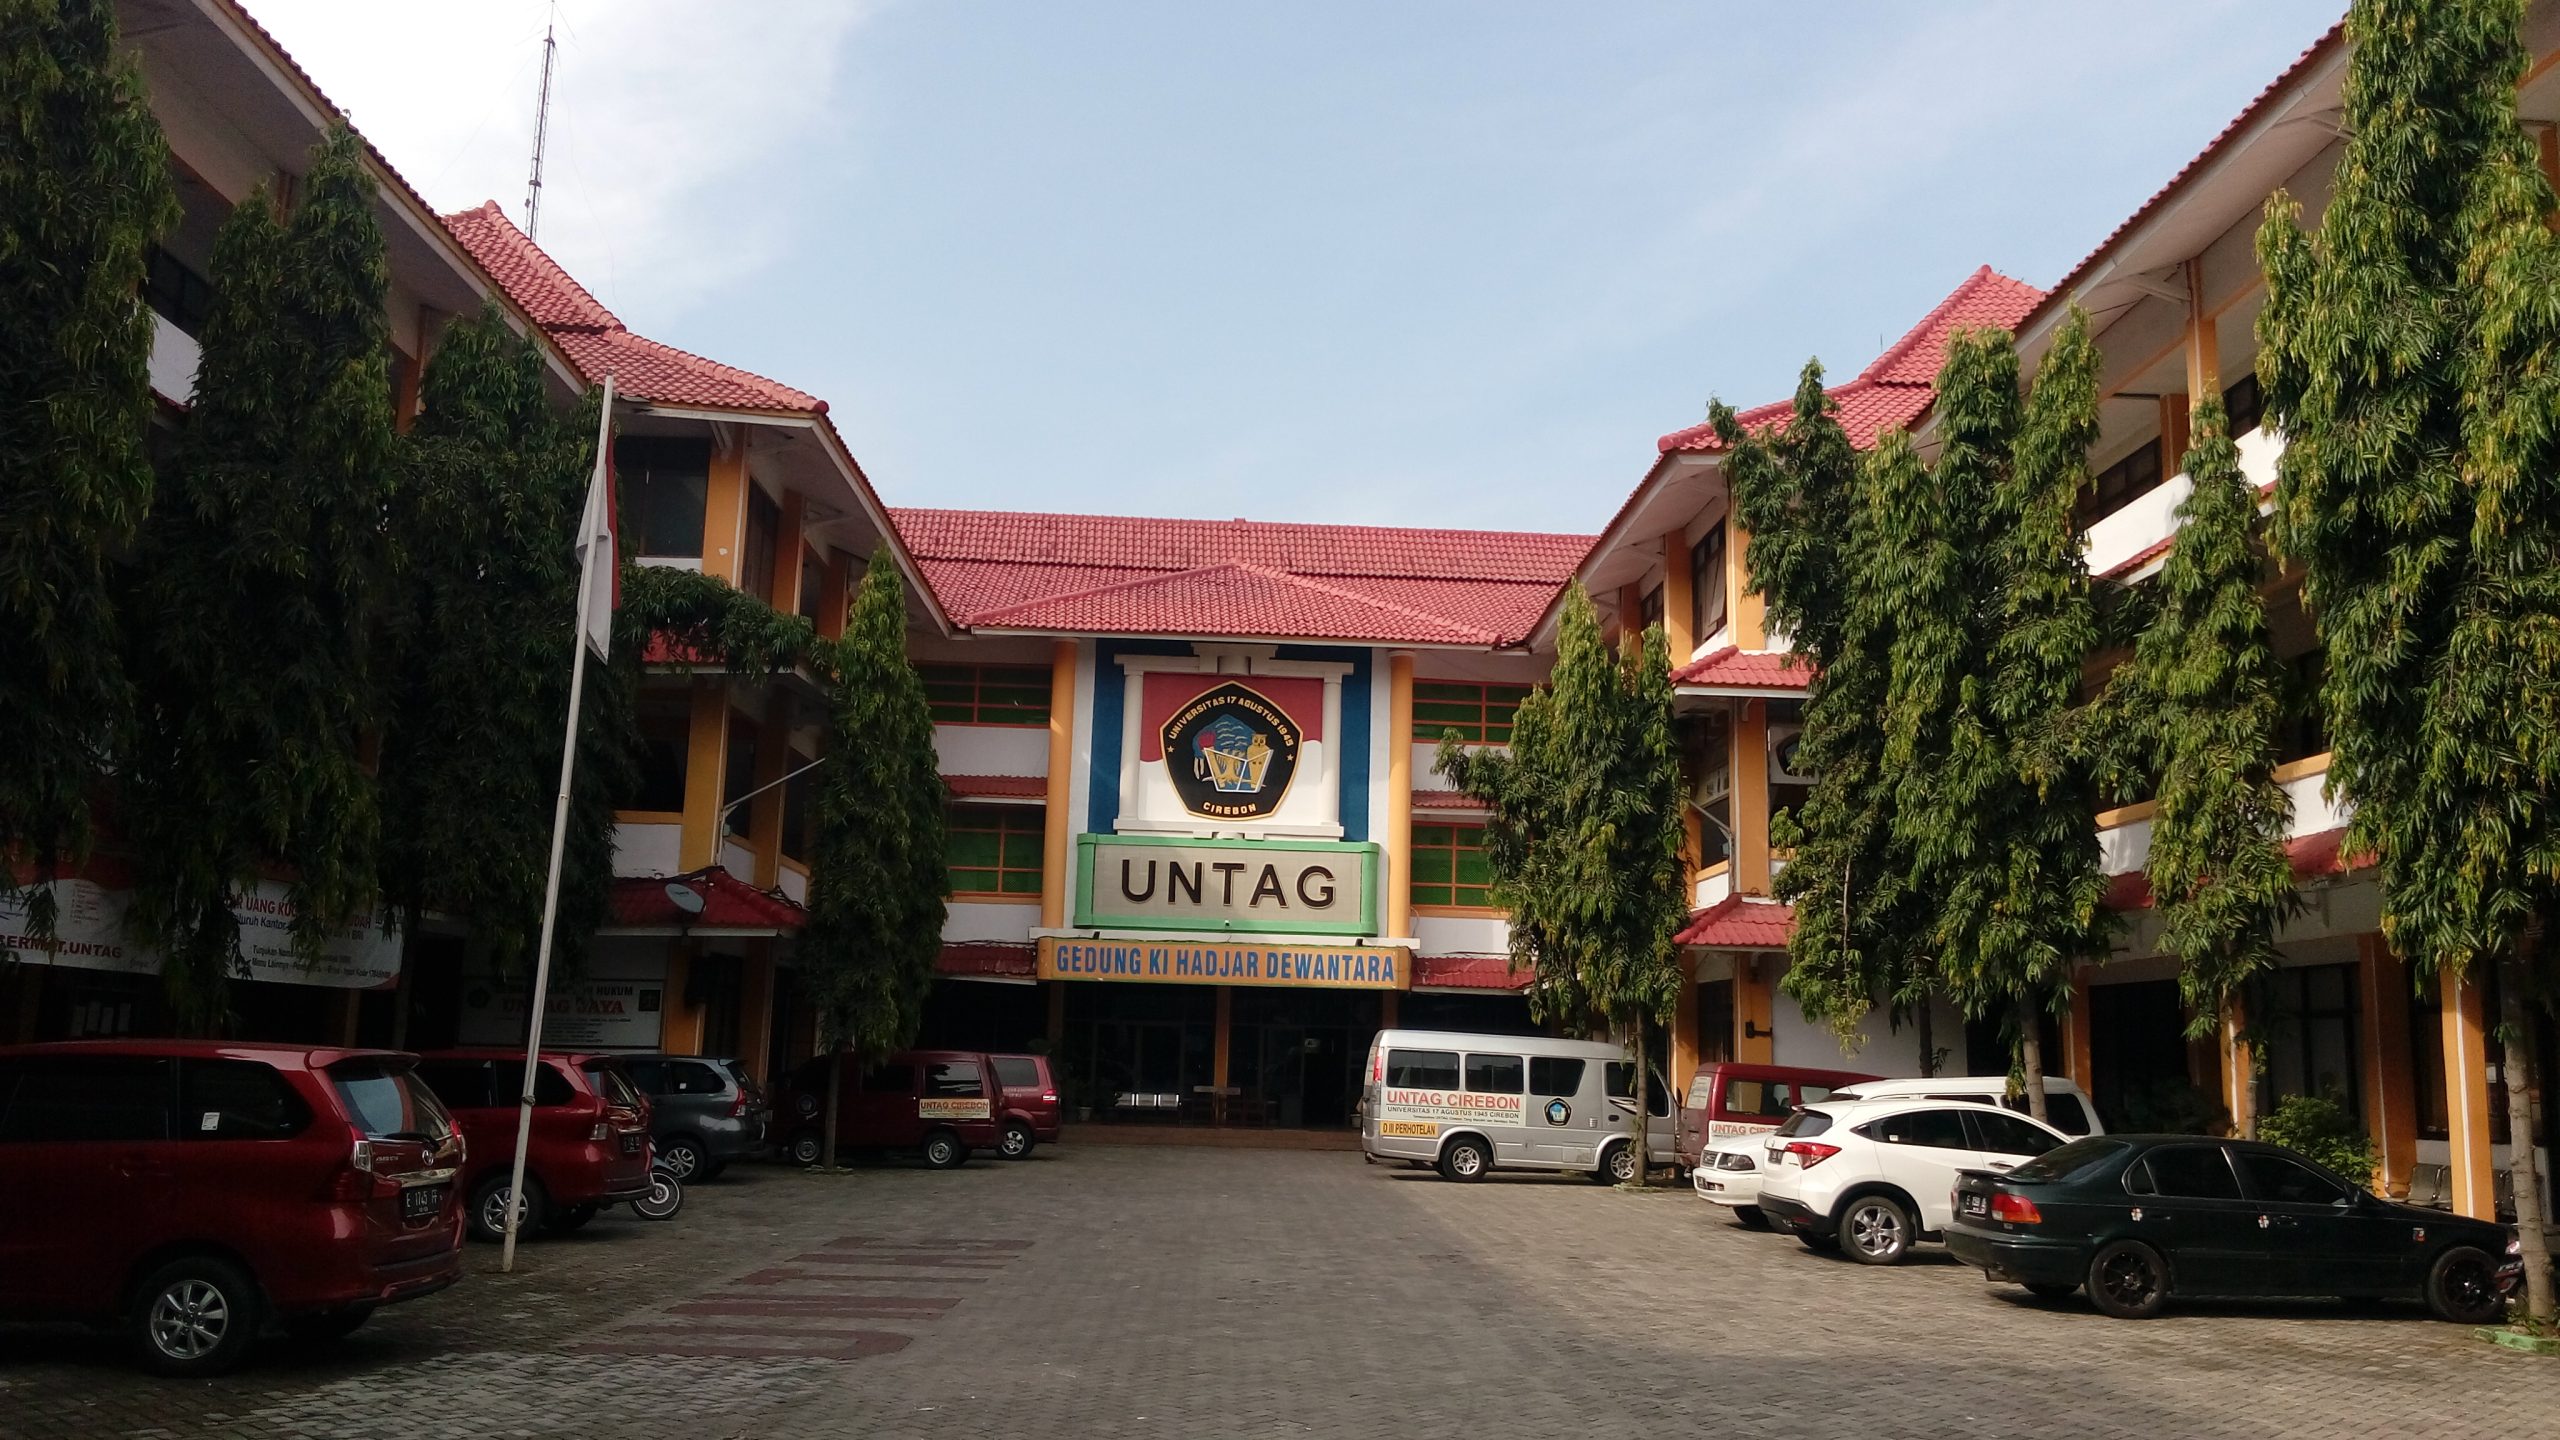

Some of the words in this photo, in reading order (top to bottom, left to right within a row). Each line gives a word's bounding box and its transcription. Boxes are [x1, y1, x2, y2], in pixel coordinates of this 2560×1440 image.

[1168, 697, 1225, 740] UNIVERSITAS
[1226, 696, 1237, 704] 17
[1238, 697, 1279, 726] AGUSTUS
[1277, 724, 1294, 747] 1945
[1203, 802, 1257, 815] CIREBON
[1121, 858, 1337, 910] UNTAG
[246, 897, 275, 914] UANG
[260, 916, 286, 929] Kantor
[1057, 945, 1141, 976] GEDUNG
[1148, 948, 1169, 975] KI
[1176, 949, 1260, 979] HADJAR
[1266, 952, 1396, 982] DEWANTARA
[596, 986, 633, 996] HUKUM
[1387, 1091, 1442, 1106] UNTAG
[1447, 1093, 1520, 1109] CIREBON
[1441, 1108, 1472, 1116] AGUSTUS
[1395, 1123, 1436, 1135] PERHOTELAN
[1711, 1124, 1746, 1135] UNTAG
[406, 1193, 411, 1208] E
